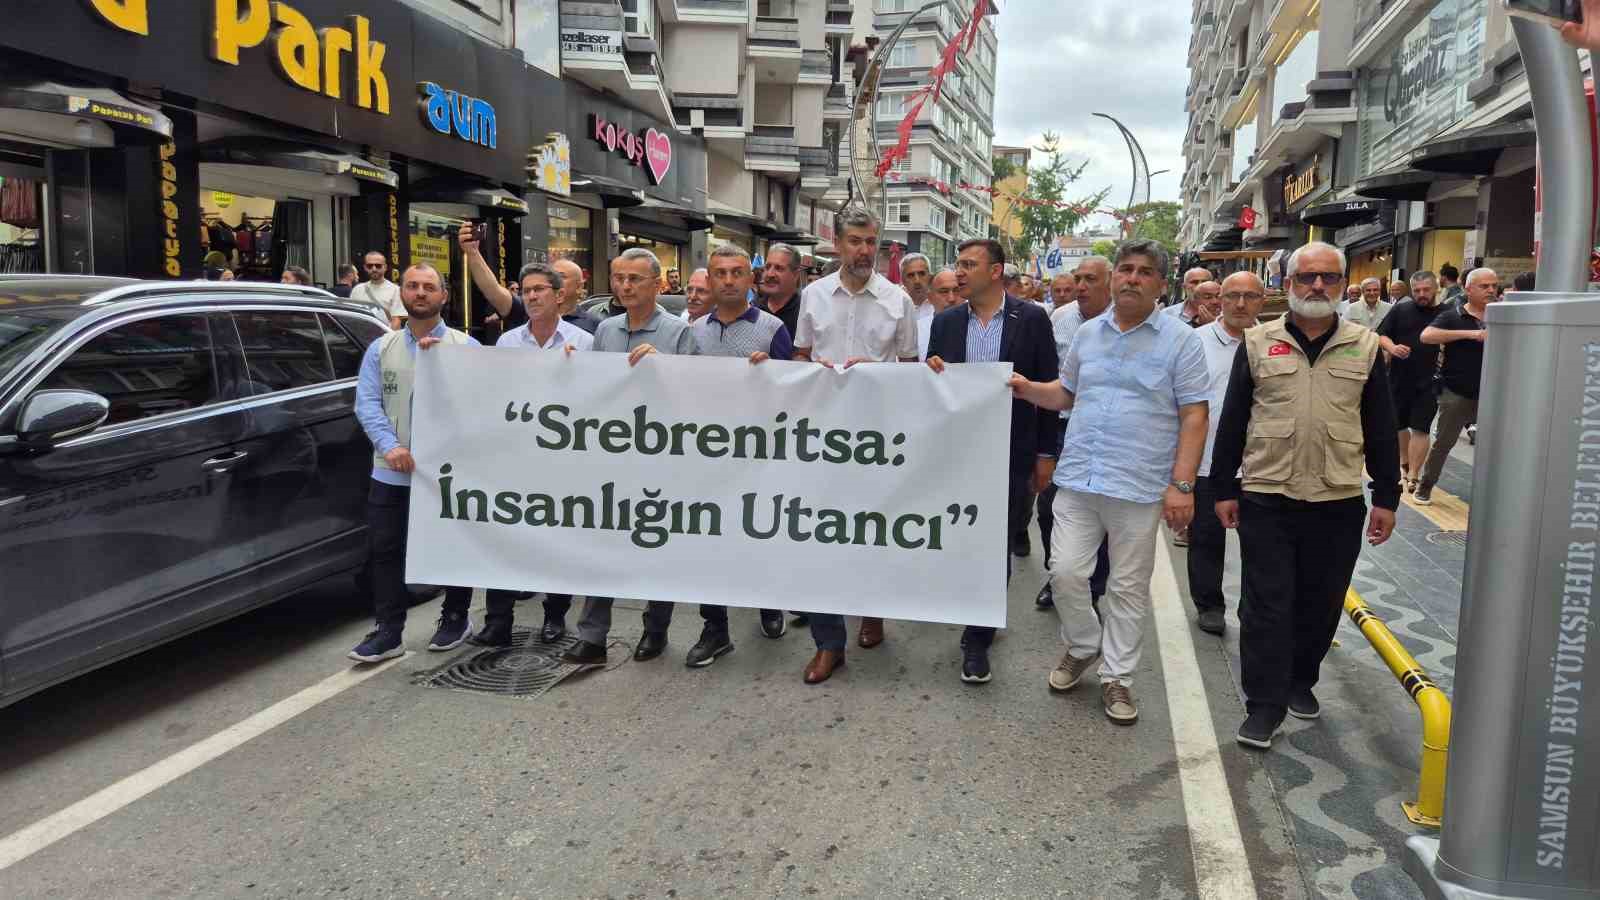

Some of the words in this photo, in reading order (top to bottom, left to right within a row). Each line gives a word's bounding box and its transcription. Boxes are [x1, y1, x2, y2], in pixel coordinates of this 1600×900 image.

[592, 112, 644, 169] KOKOŞ
[1345, 202, 1369, 210] ZULA
[504, 401, 906, 467] “Srebrenitsa:
[438, 462, 722, 549] İnsanlığın
[741, 492, 979, 551] Utancı”
[1546, 541, 1597, 735] BÜYÜKŞEHİR
[1536, 742, 1575, 869] SAMSUN
